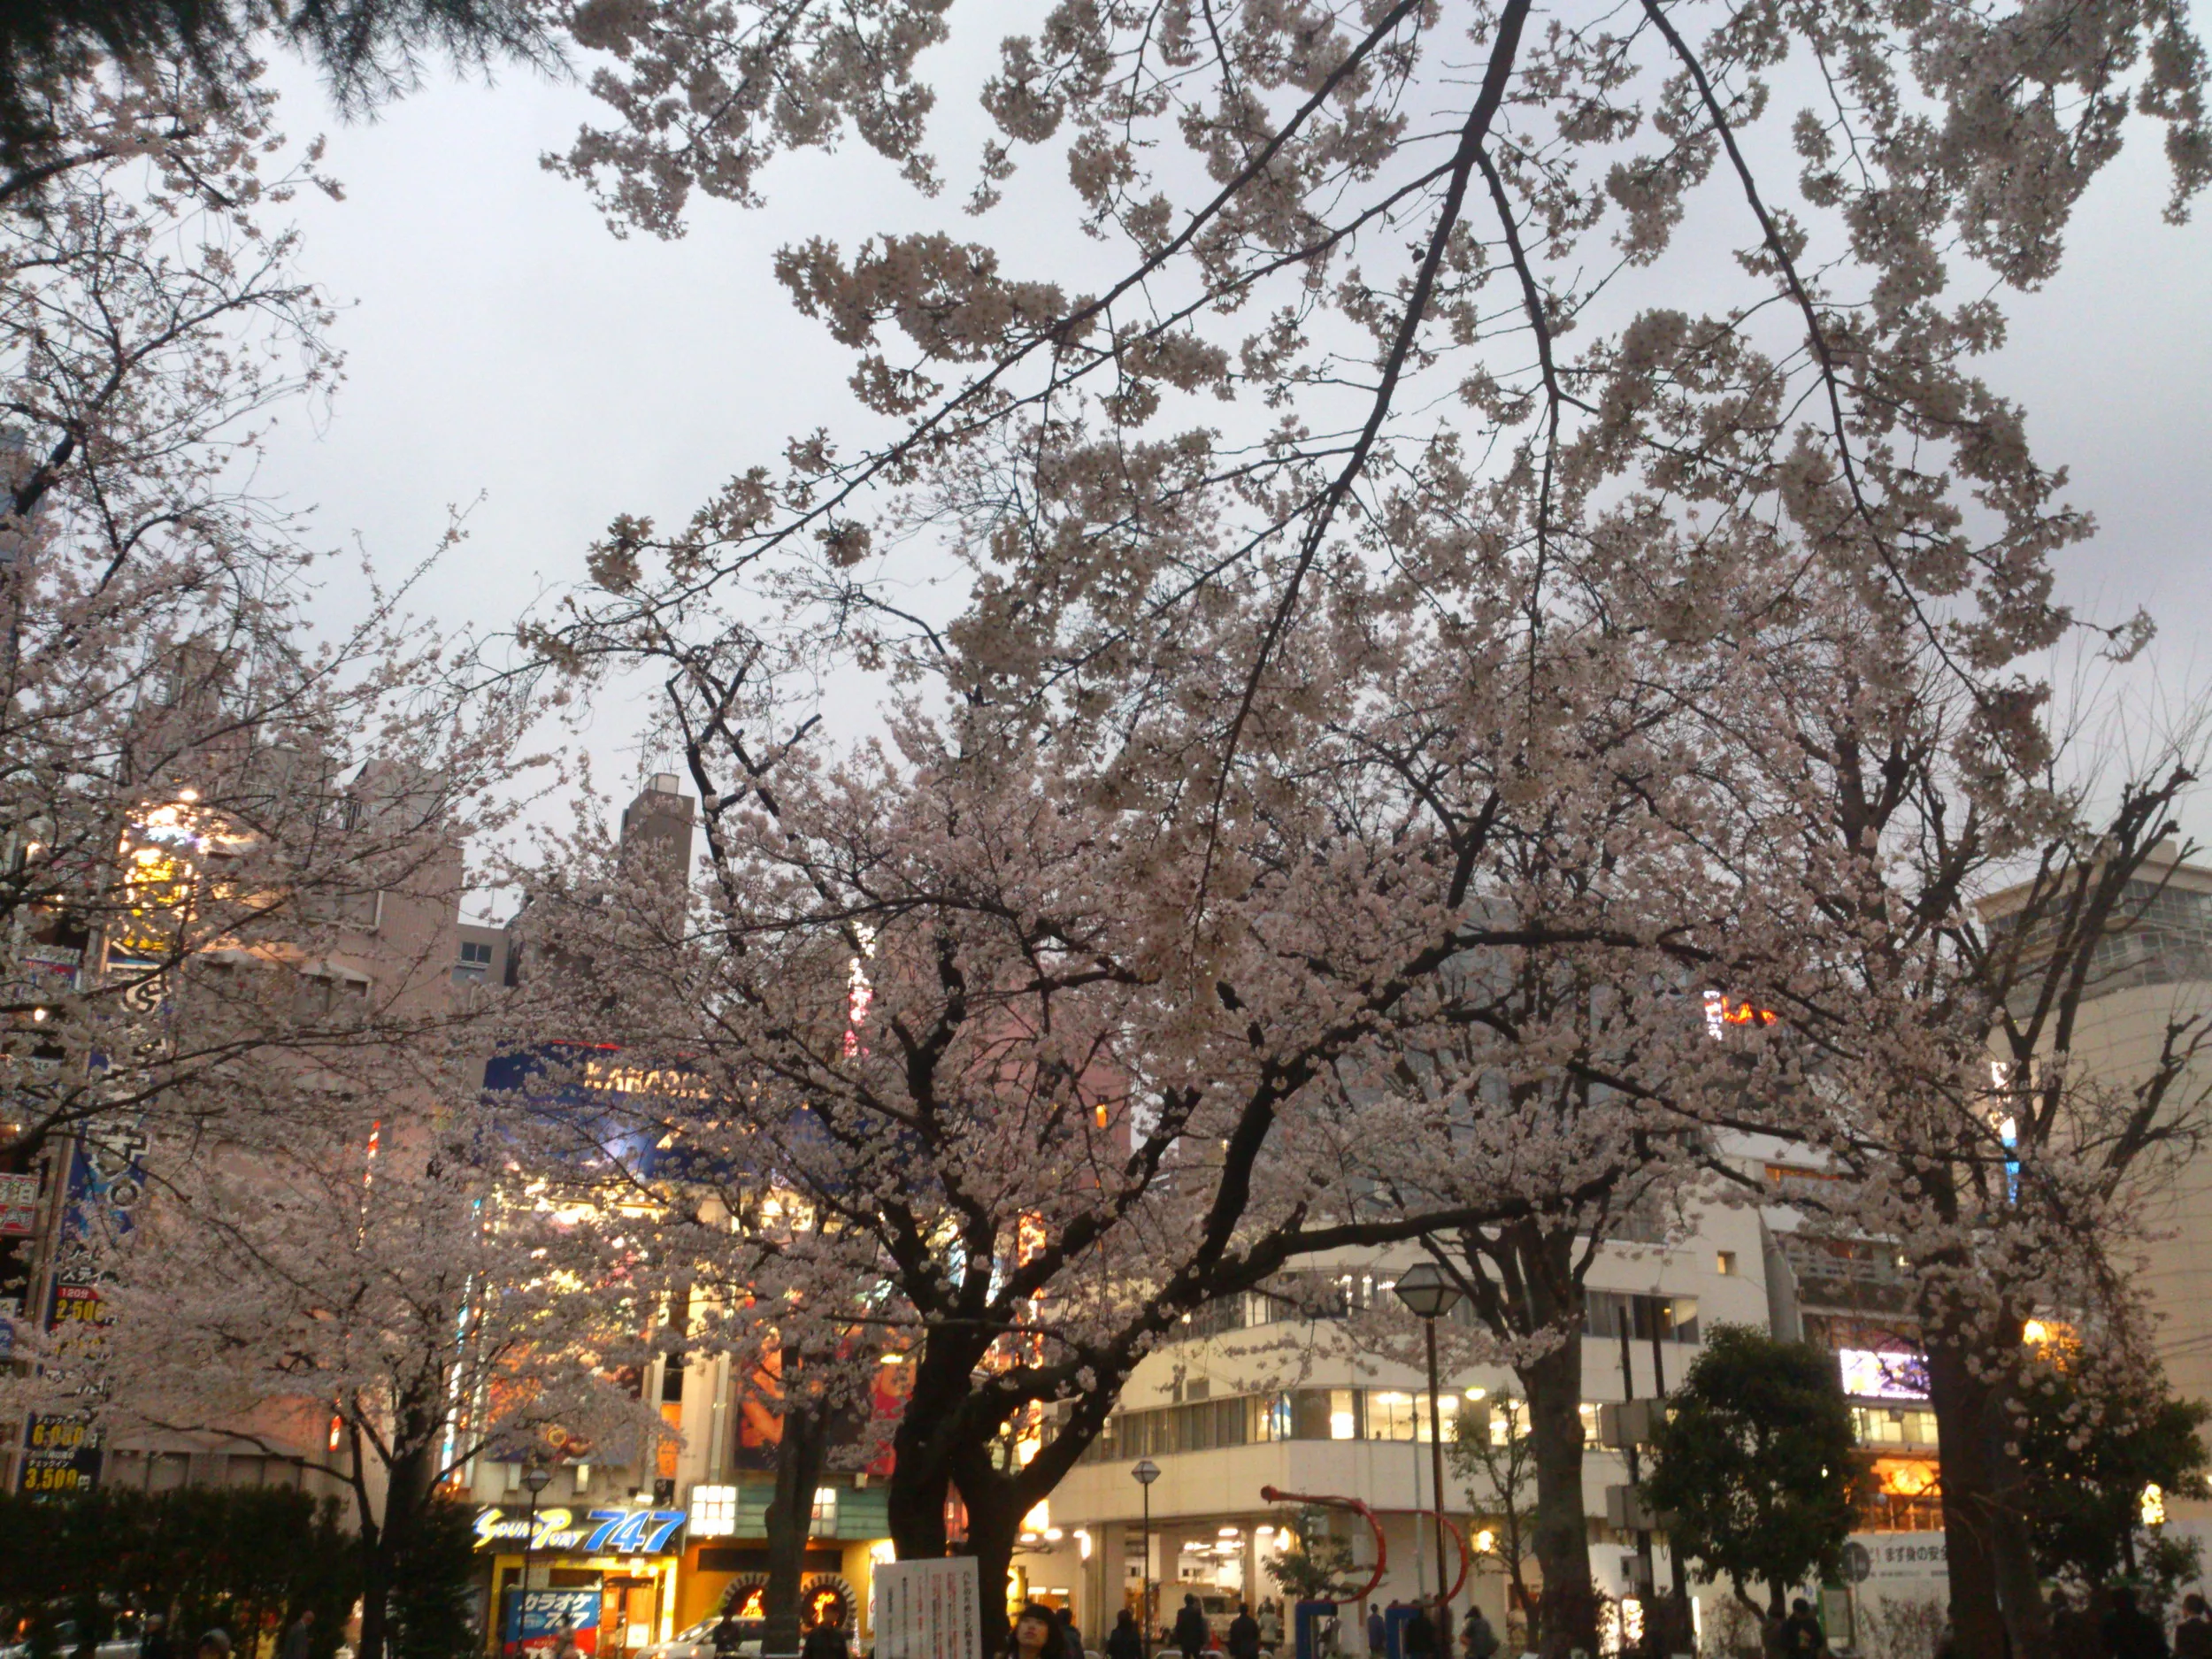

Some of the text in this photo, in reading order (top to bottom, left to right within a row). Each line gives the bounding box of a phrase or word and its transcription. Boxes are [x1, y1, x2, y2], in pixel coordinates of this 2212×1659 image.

[61, 1288, 89, 1299] 120分
[584, 1509, 687, 1553] 747
[518, 1593, 593, 1612] カラオケ
